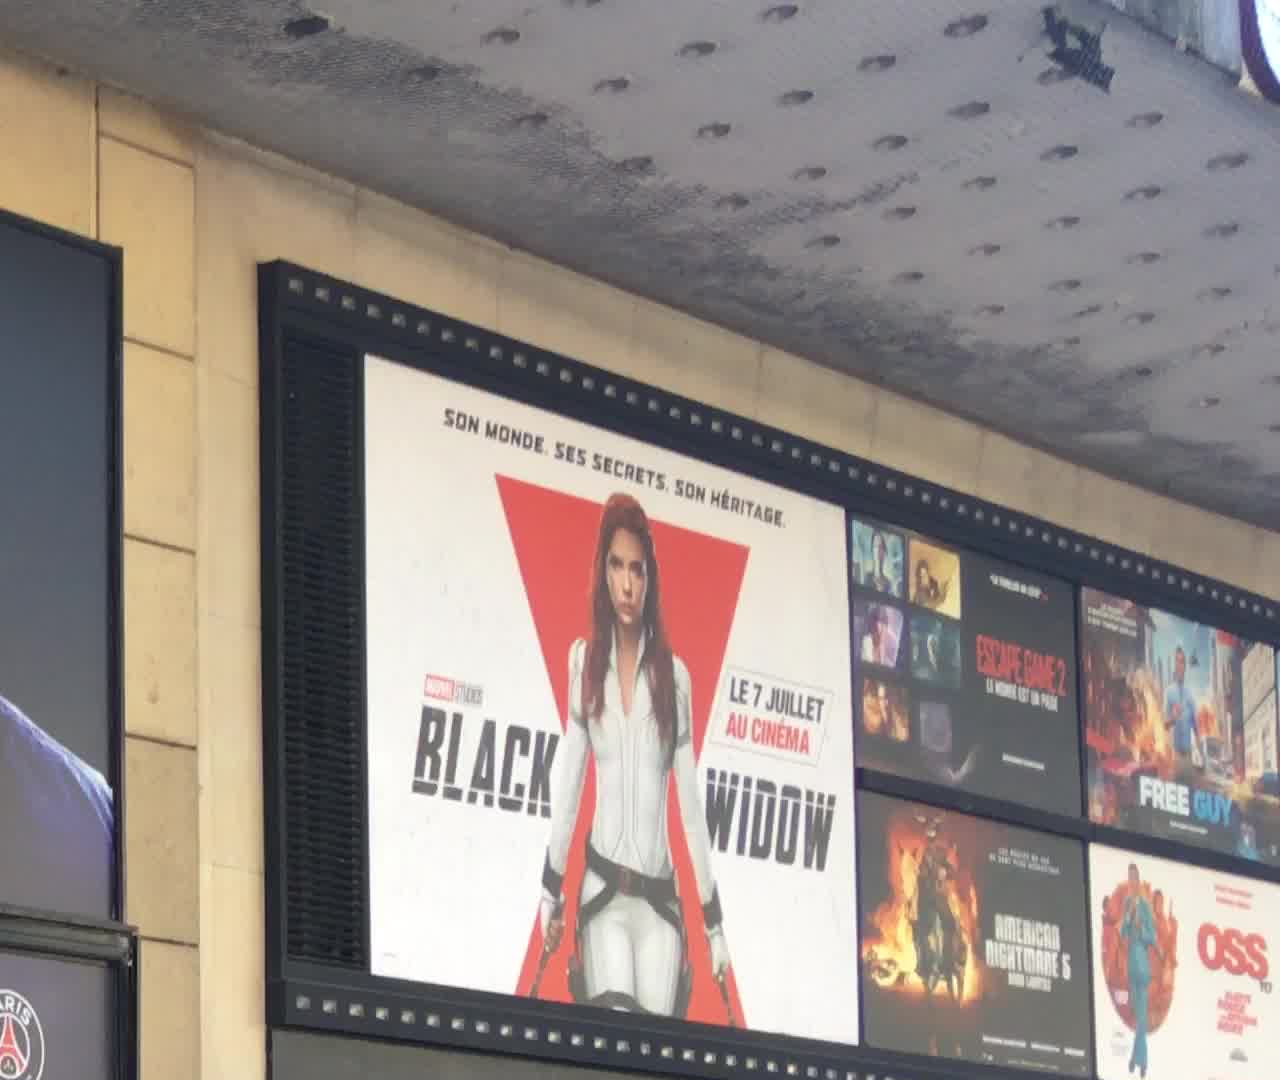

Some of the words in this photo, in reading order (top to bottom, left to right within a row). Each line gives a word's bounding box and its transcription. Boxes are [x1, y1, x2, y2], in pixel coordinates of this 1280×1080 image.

[444, 408, 479, 434] SON
[485, 420, 549, 455] MONDE.
[554, 442, 587, 466] SES
[592, 454, 669, 492] SECRETS.
[675, 479, 706, 505] SON
[730, 677, 749, 704] LE
[753, 684, 762, 707] 7
[766, 687, 824, 724] JUILLET
[412, 704, 560, 818] BLACK
[726, 712, 748, 740] AU
[751, 716, 810, 755] CINÉMA
[705, 767, 837, 872] WIDOW
[1140, 775, 1190, 816] FREE
[1193, 789, 1233, 825] GUY
[1197, 922, 1269, 981] OSS
